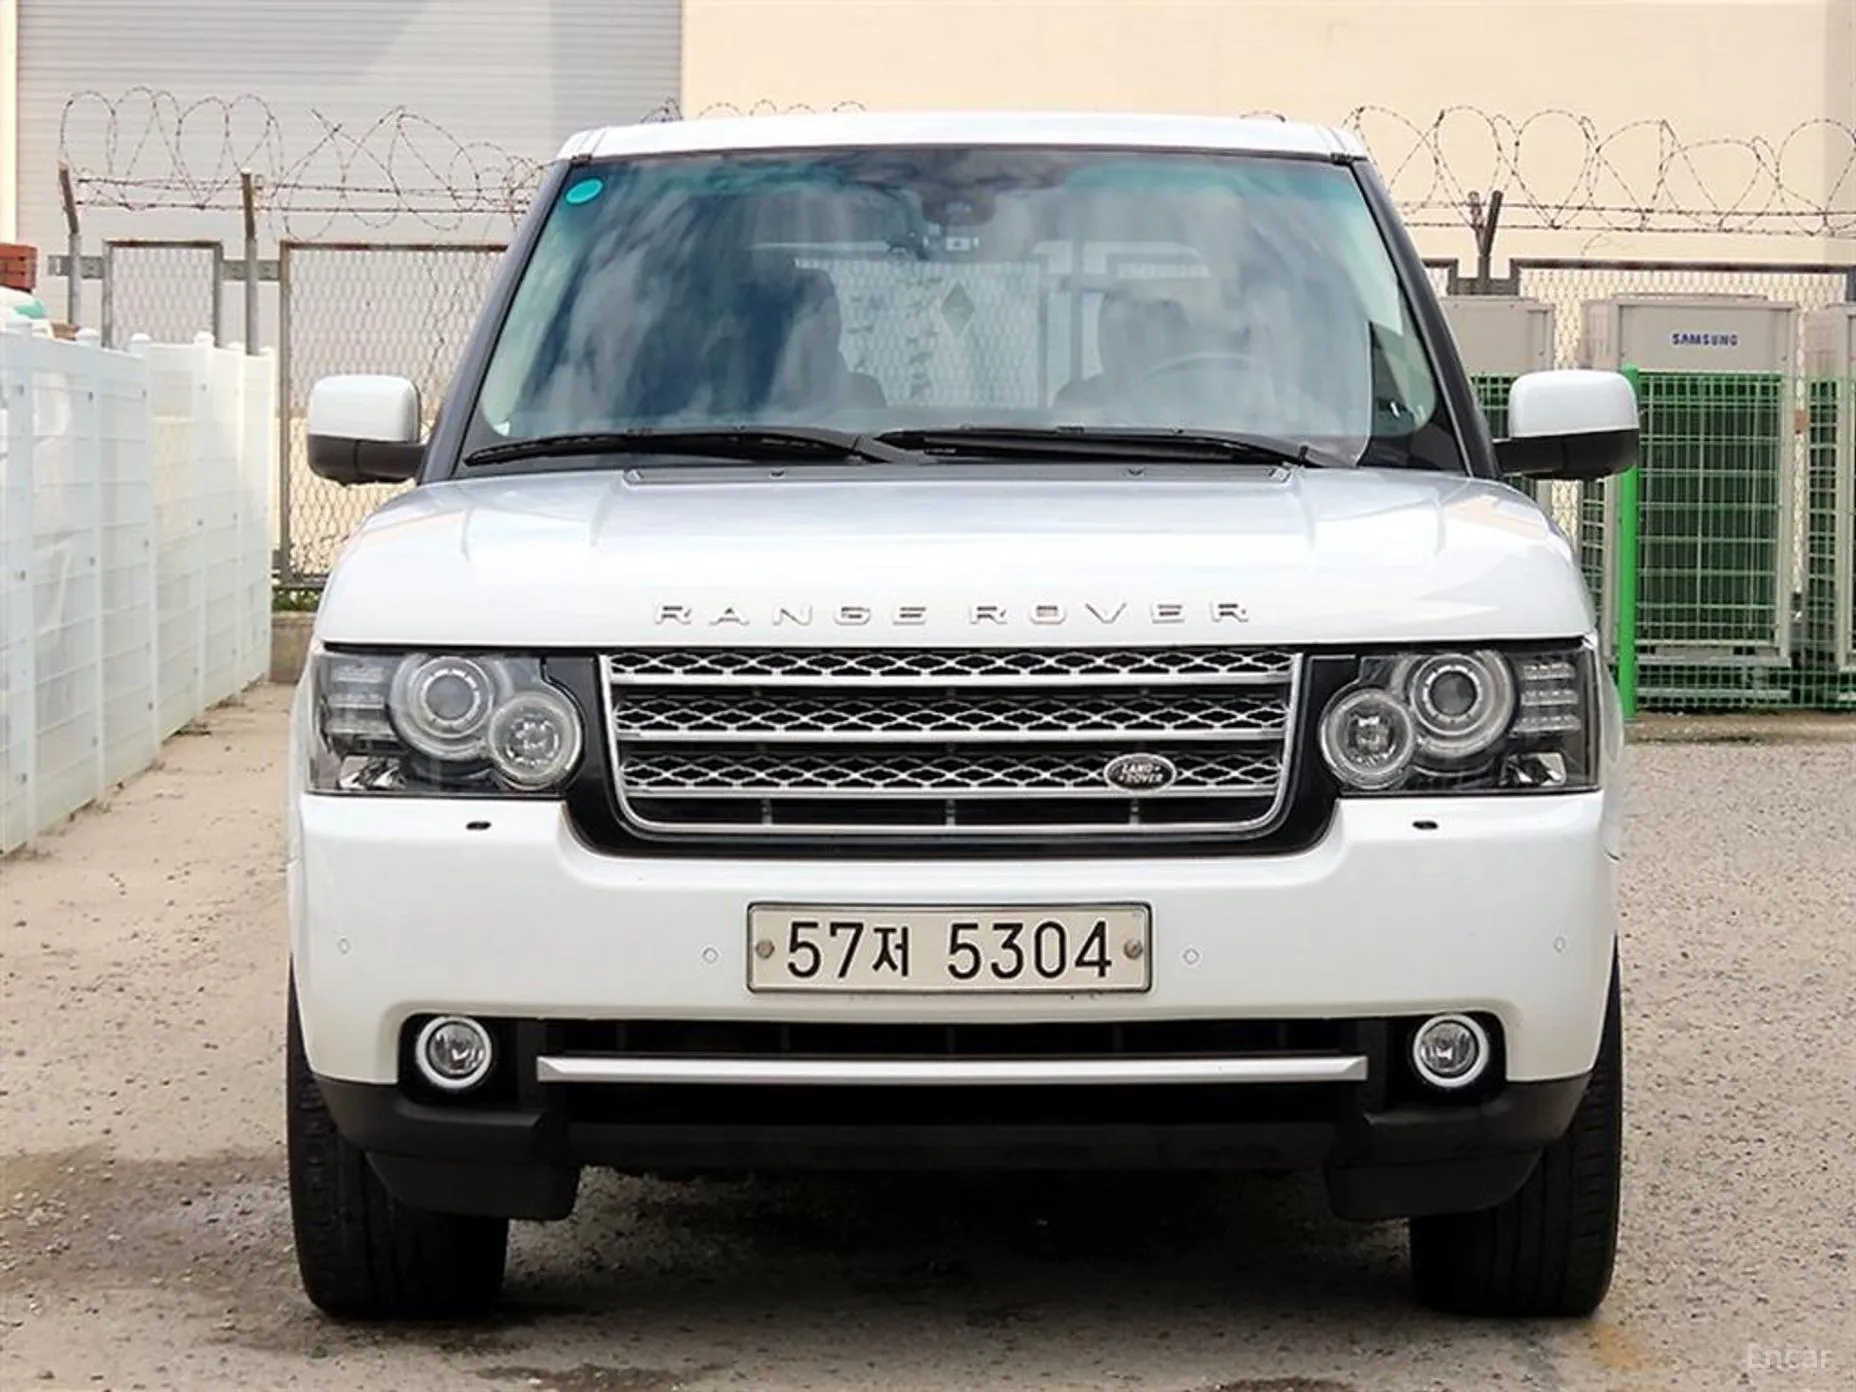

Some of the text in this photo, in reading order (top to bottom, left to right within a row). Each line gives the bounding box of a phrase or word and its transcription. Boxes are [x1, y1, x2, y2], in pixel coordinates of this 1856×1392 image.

[1672, 333, 1738, 346] SAMSUNG
[655, 604, 1249, 625] RANGE ROVER
[787, 921, 1112, 979] 57저 5304
